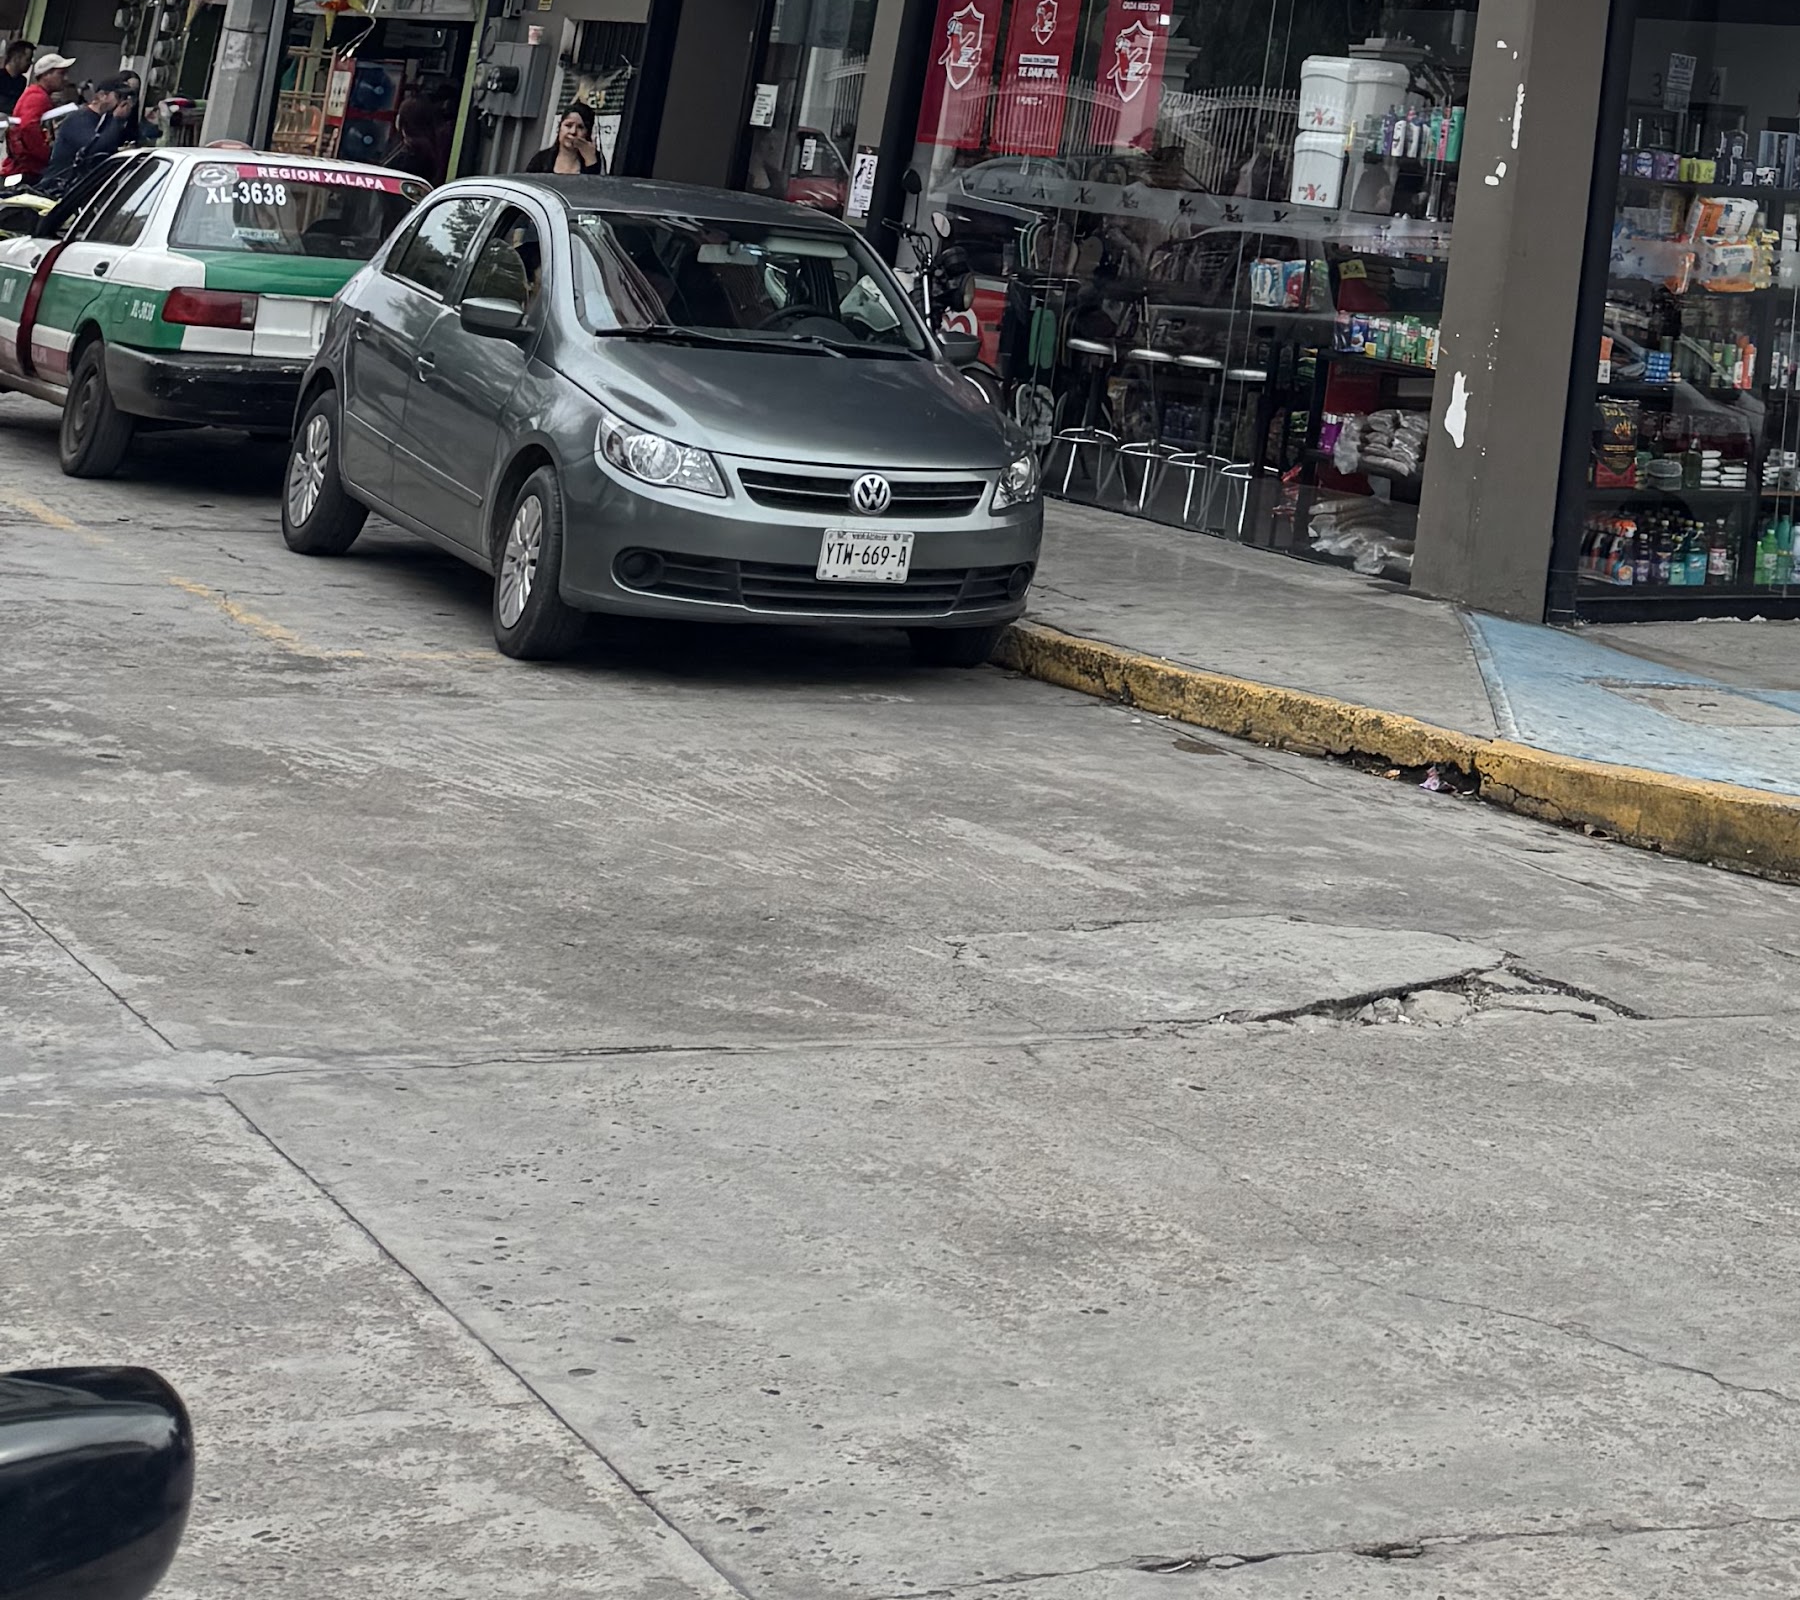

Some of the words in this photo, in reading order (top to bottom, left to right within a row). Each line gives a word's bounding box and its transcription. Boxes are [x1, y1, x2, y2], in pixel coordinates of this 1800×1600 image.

[256, 166, 320, 183] REGION
[322, 171, 386, 191] XALAPA
[205, 181, 287, 206] XL-3638
[826, 542, 907, 568] YTW-669-A
